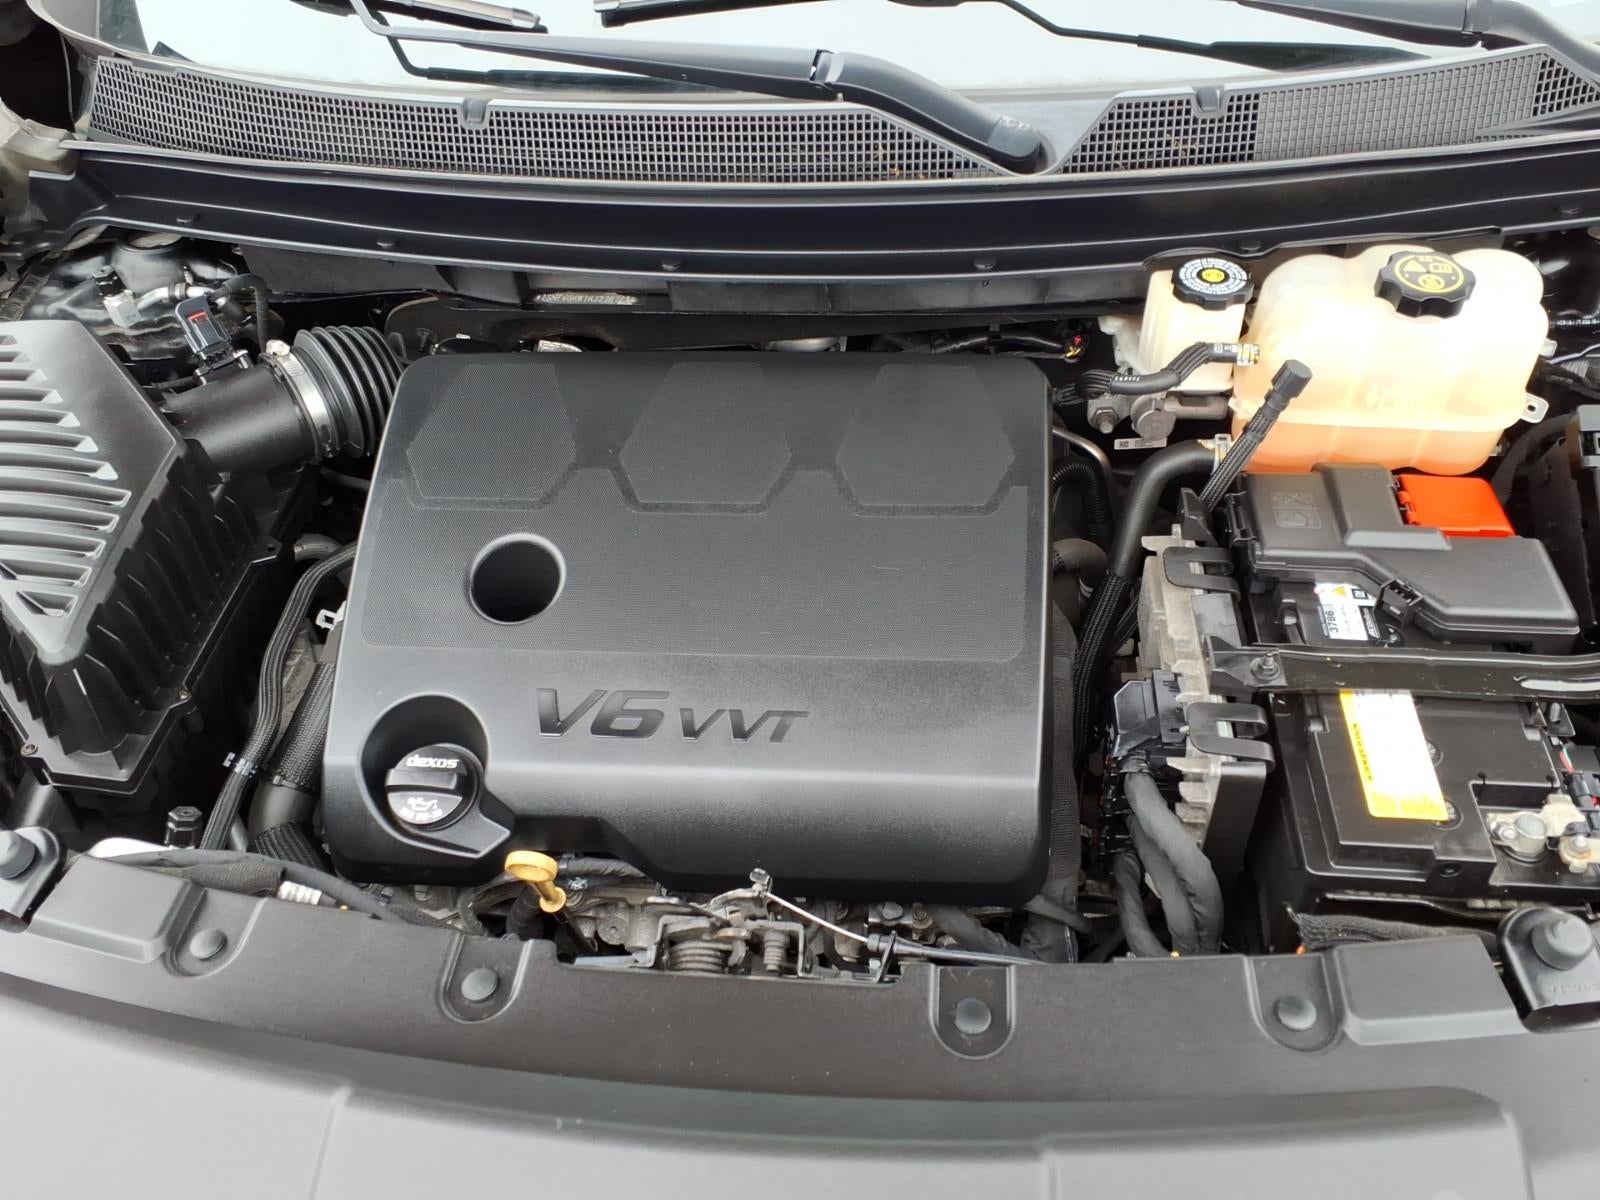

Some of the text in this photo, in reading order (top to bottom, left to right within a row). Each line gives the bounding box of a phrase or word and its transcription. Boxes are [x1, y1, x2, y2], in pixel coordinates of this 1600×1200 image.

[1325, 610, 1339, 633] 3786
[536, 688, 810, 742] V6 VVT
[406, 754, 460, 769] dexos
